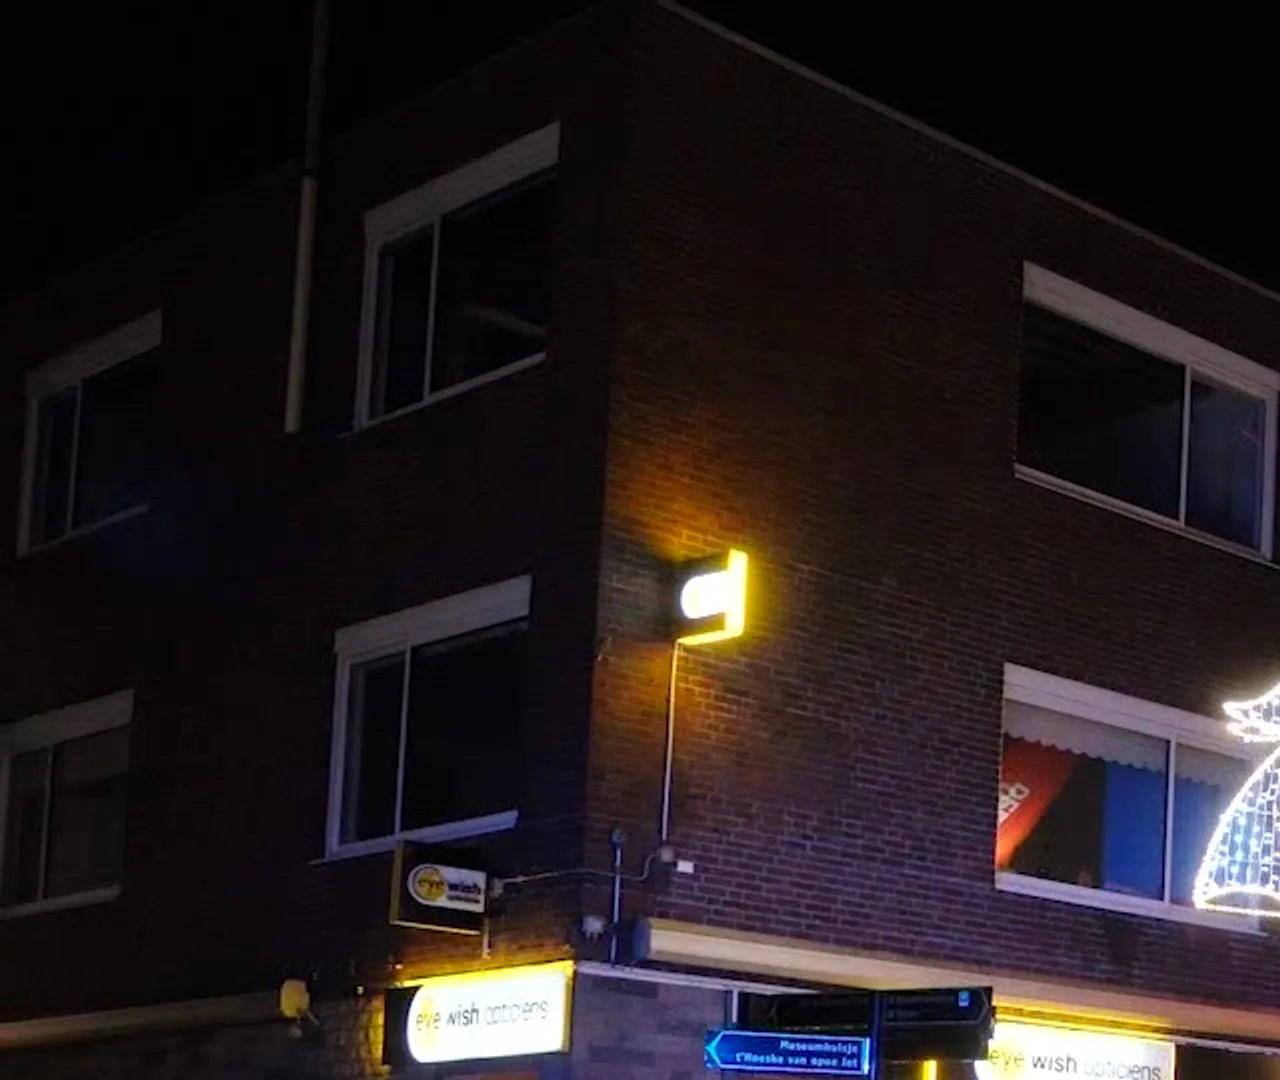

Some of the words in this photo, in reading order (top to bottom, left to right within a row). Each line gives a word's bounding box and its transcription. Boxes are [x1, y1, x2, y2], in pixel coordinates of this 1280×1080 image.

[415, 1010, 441, 1032] eye
[446, 1001, 480, 1027] wish
[787, 1056, 808, 1065] van
[988, 1049, 1025, 1071] eye
[1031, 1053, 1078, 1074] wish
